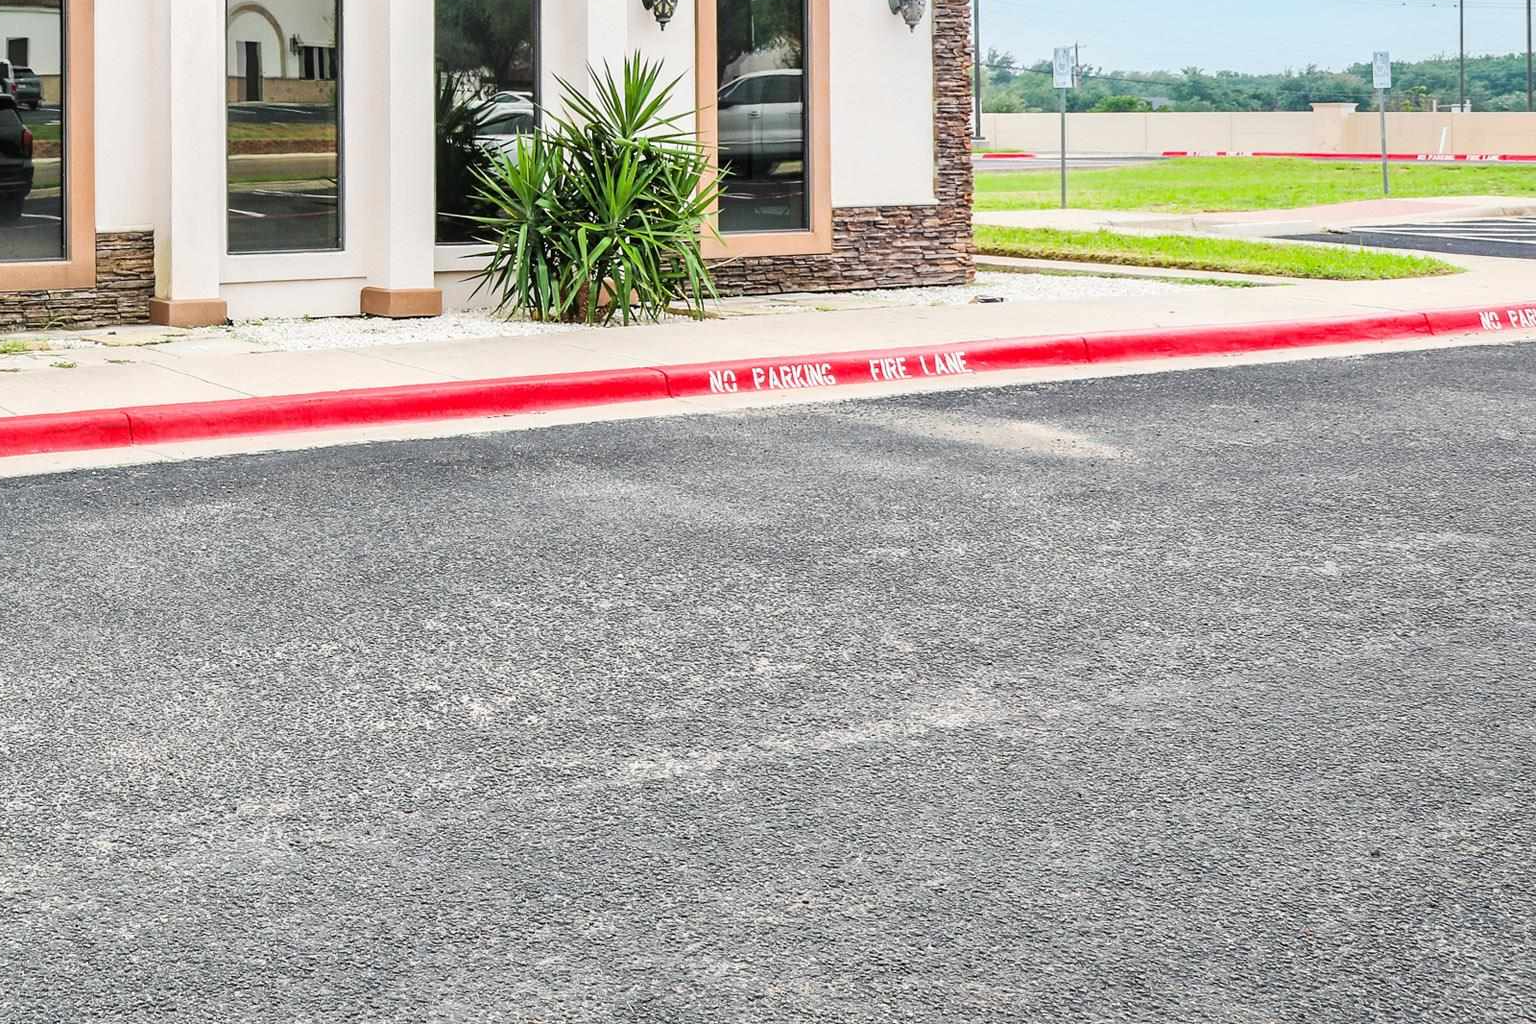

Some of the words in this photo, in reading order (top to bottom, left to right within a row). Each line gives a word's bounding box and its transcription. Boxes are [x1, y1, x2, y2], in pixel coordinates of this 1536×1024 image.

[1479, 311, 1502, 330] NO
[708, 369, 737, 394] NO
[752, 362, 836, 391] PARKING
[868, 356, 912, 381] FIRE
[919, 351, 974, 376] LANE
